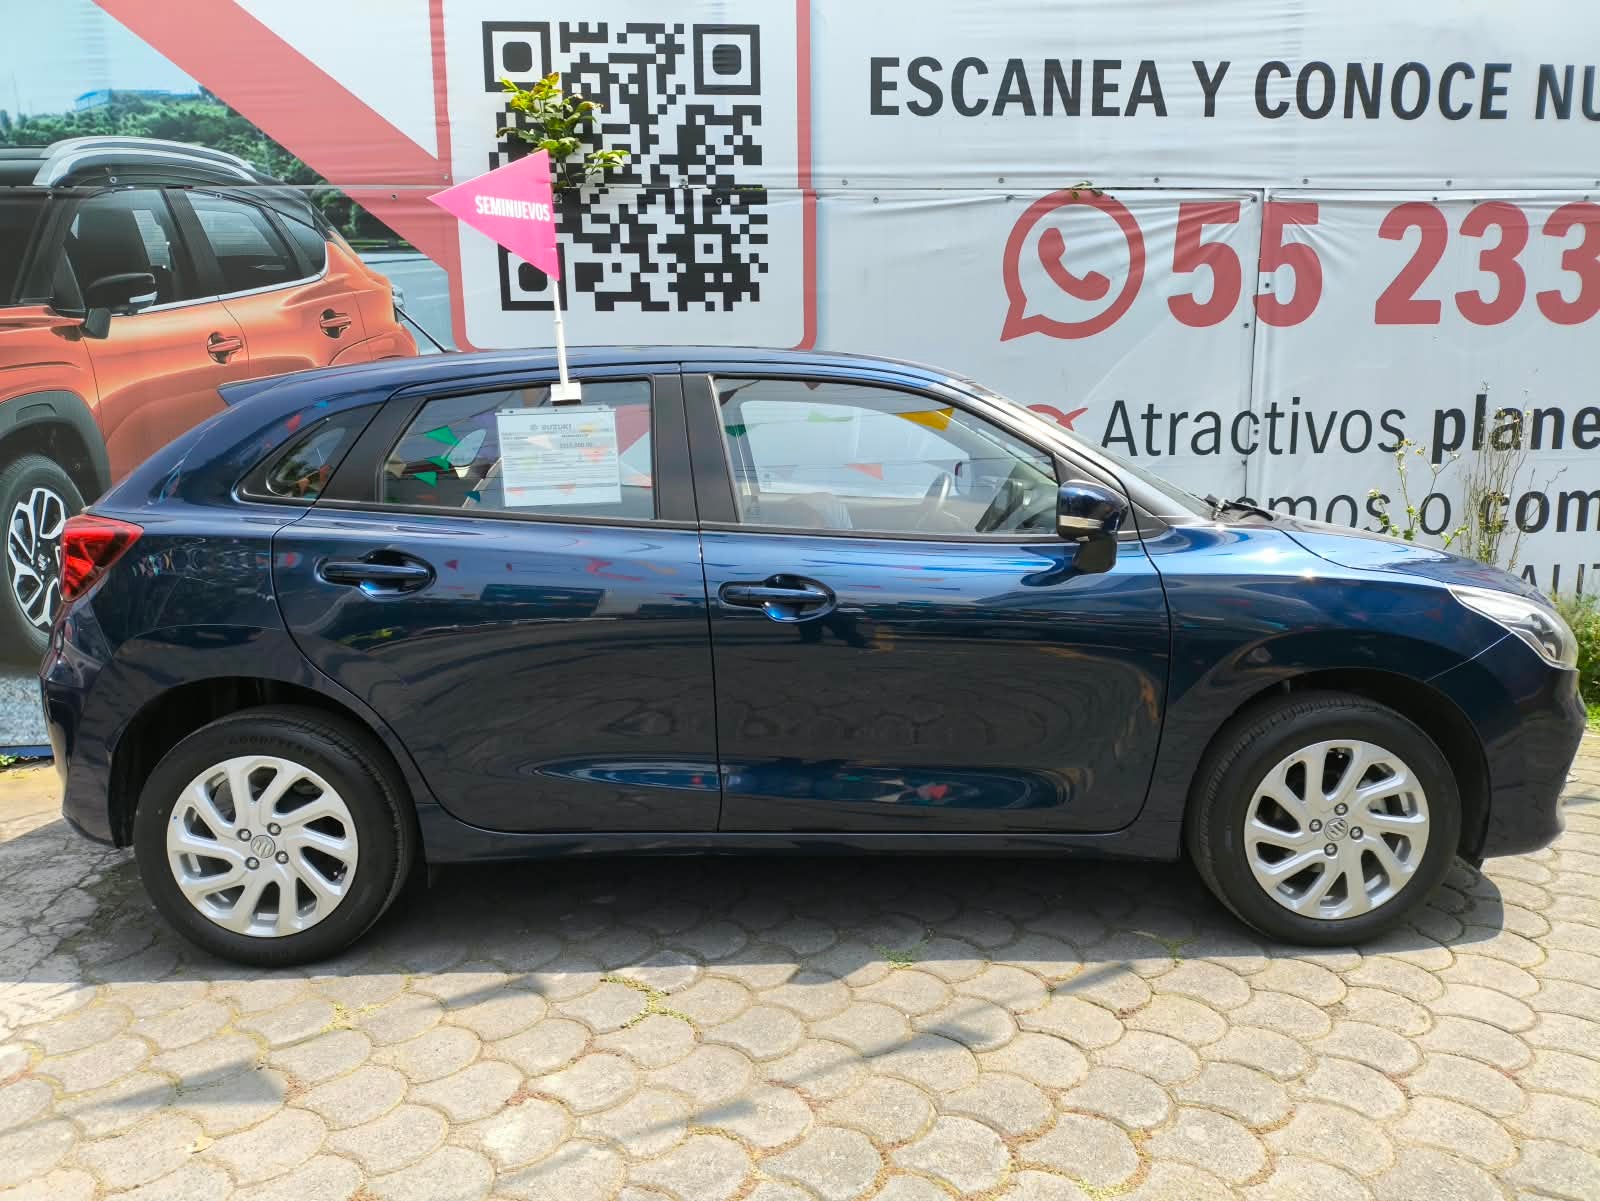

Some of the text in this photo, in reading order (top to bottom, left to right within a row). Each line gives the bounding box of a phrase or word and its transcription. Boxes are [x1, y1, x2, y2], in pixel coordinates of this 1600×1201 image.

[870, 56, 1168, 117] ESCANEA
[1192, 60, 1231, 117] Y
[1254, 60, 1512, 121] CONOCE
[475, 195, 551, 222] SEMINUEVOS
[1167, 200, 1600, 328] 55 233
[1100, 394, 1600, 465] Atractivos plane
[1420, 492, 1452, 536] o
